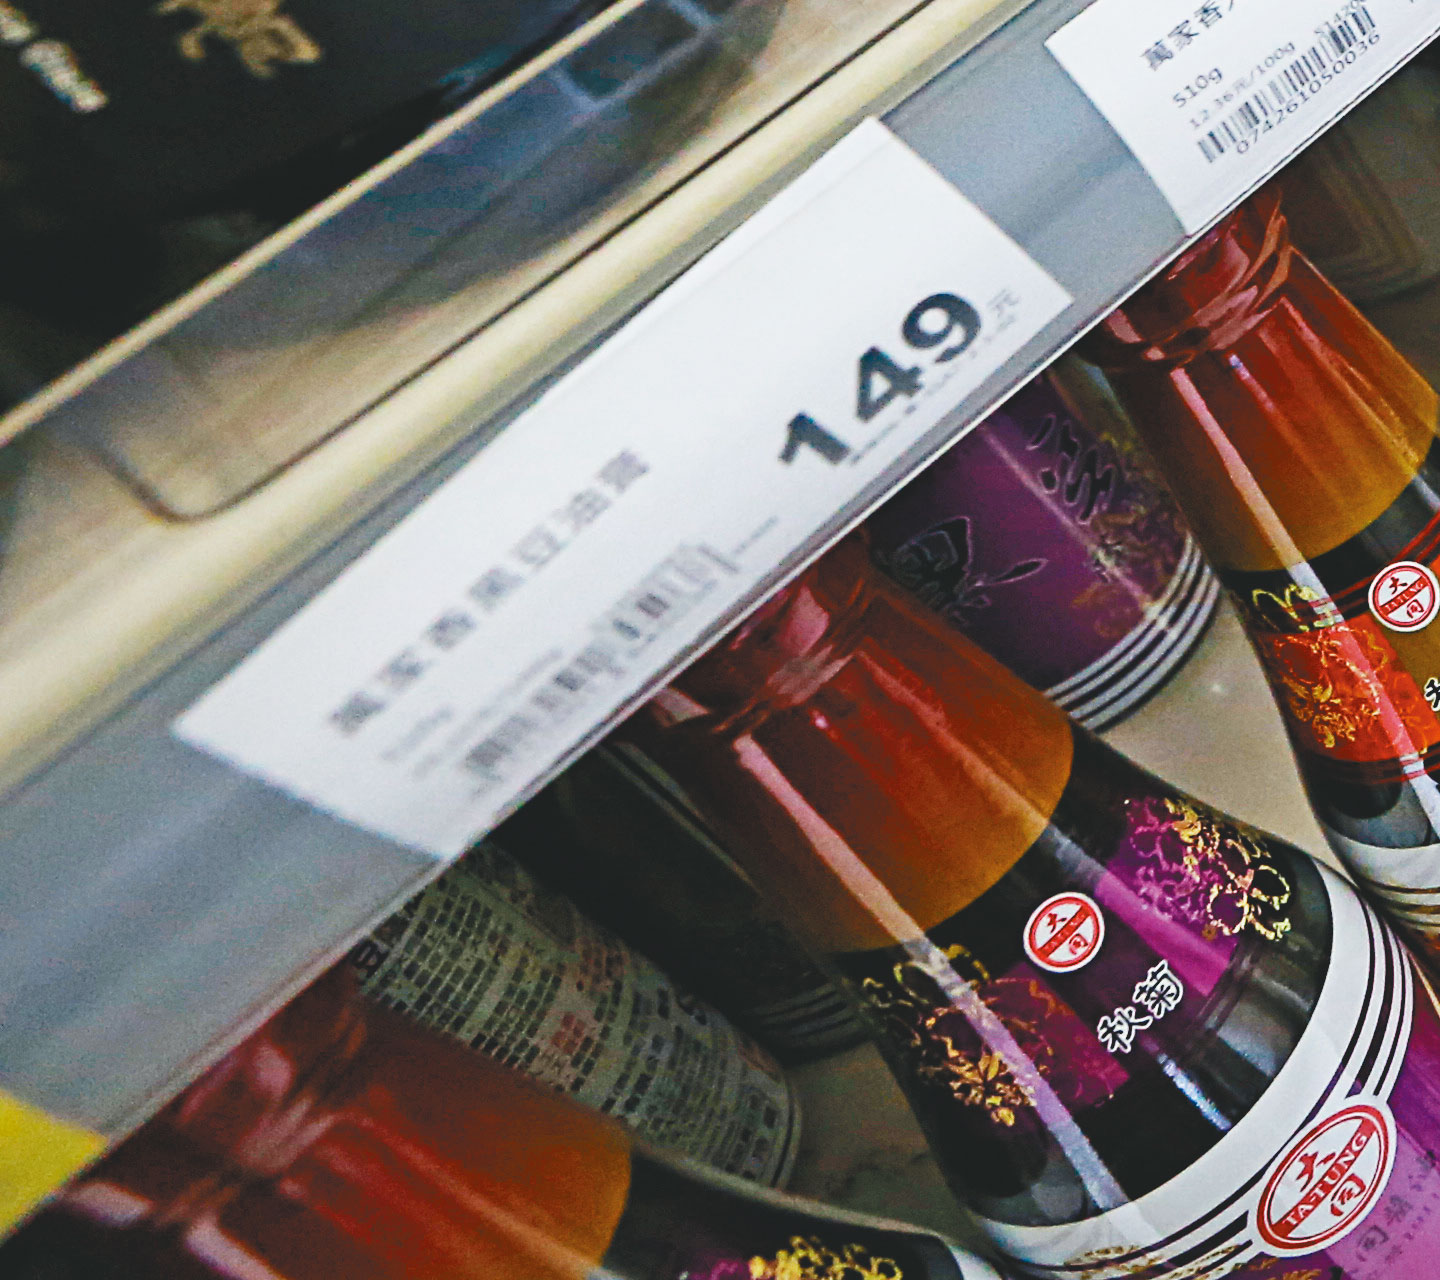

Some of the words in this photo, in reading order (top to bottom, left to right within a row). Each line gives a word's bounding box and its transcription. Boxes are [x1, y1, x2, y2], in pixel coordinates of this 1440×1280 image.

[1172, 65, 1223, 109] 510g
[1236, 32, 1382, 156] 074261050036
[776, 291, 982, 468] 149
[1097, 959, 1184, 1055] 秋菊
[1279, 1129, 1371, 1229] TA-TUNG
